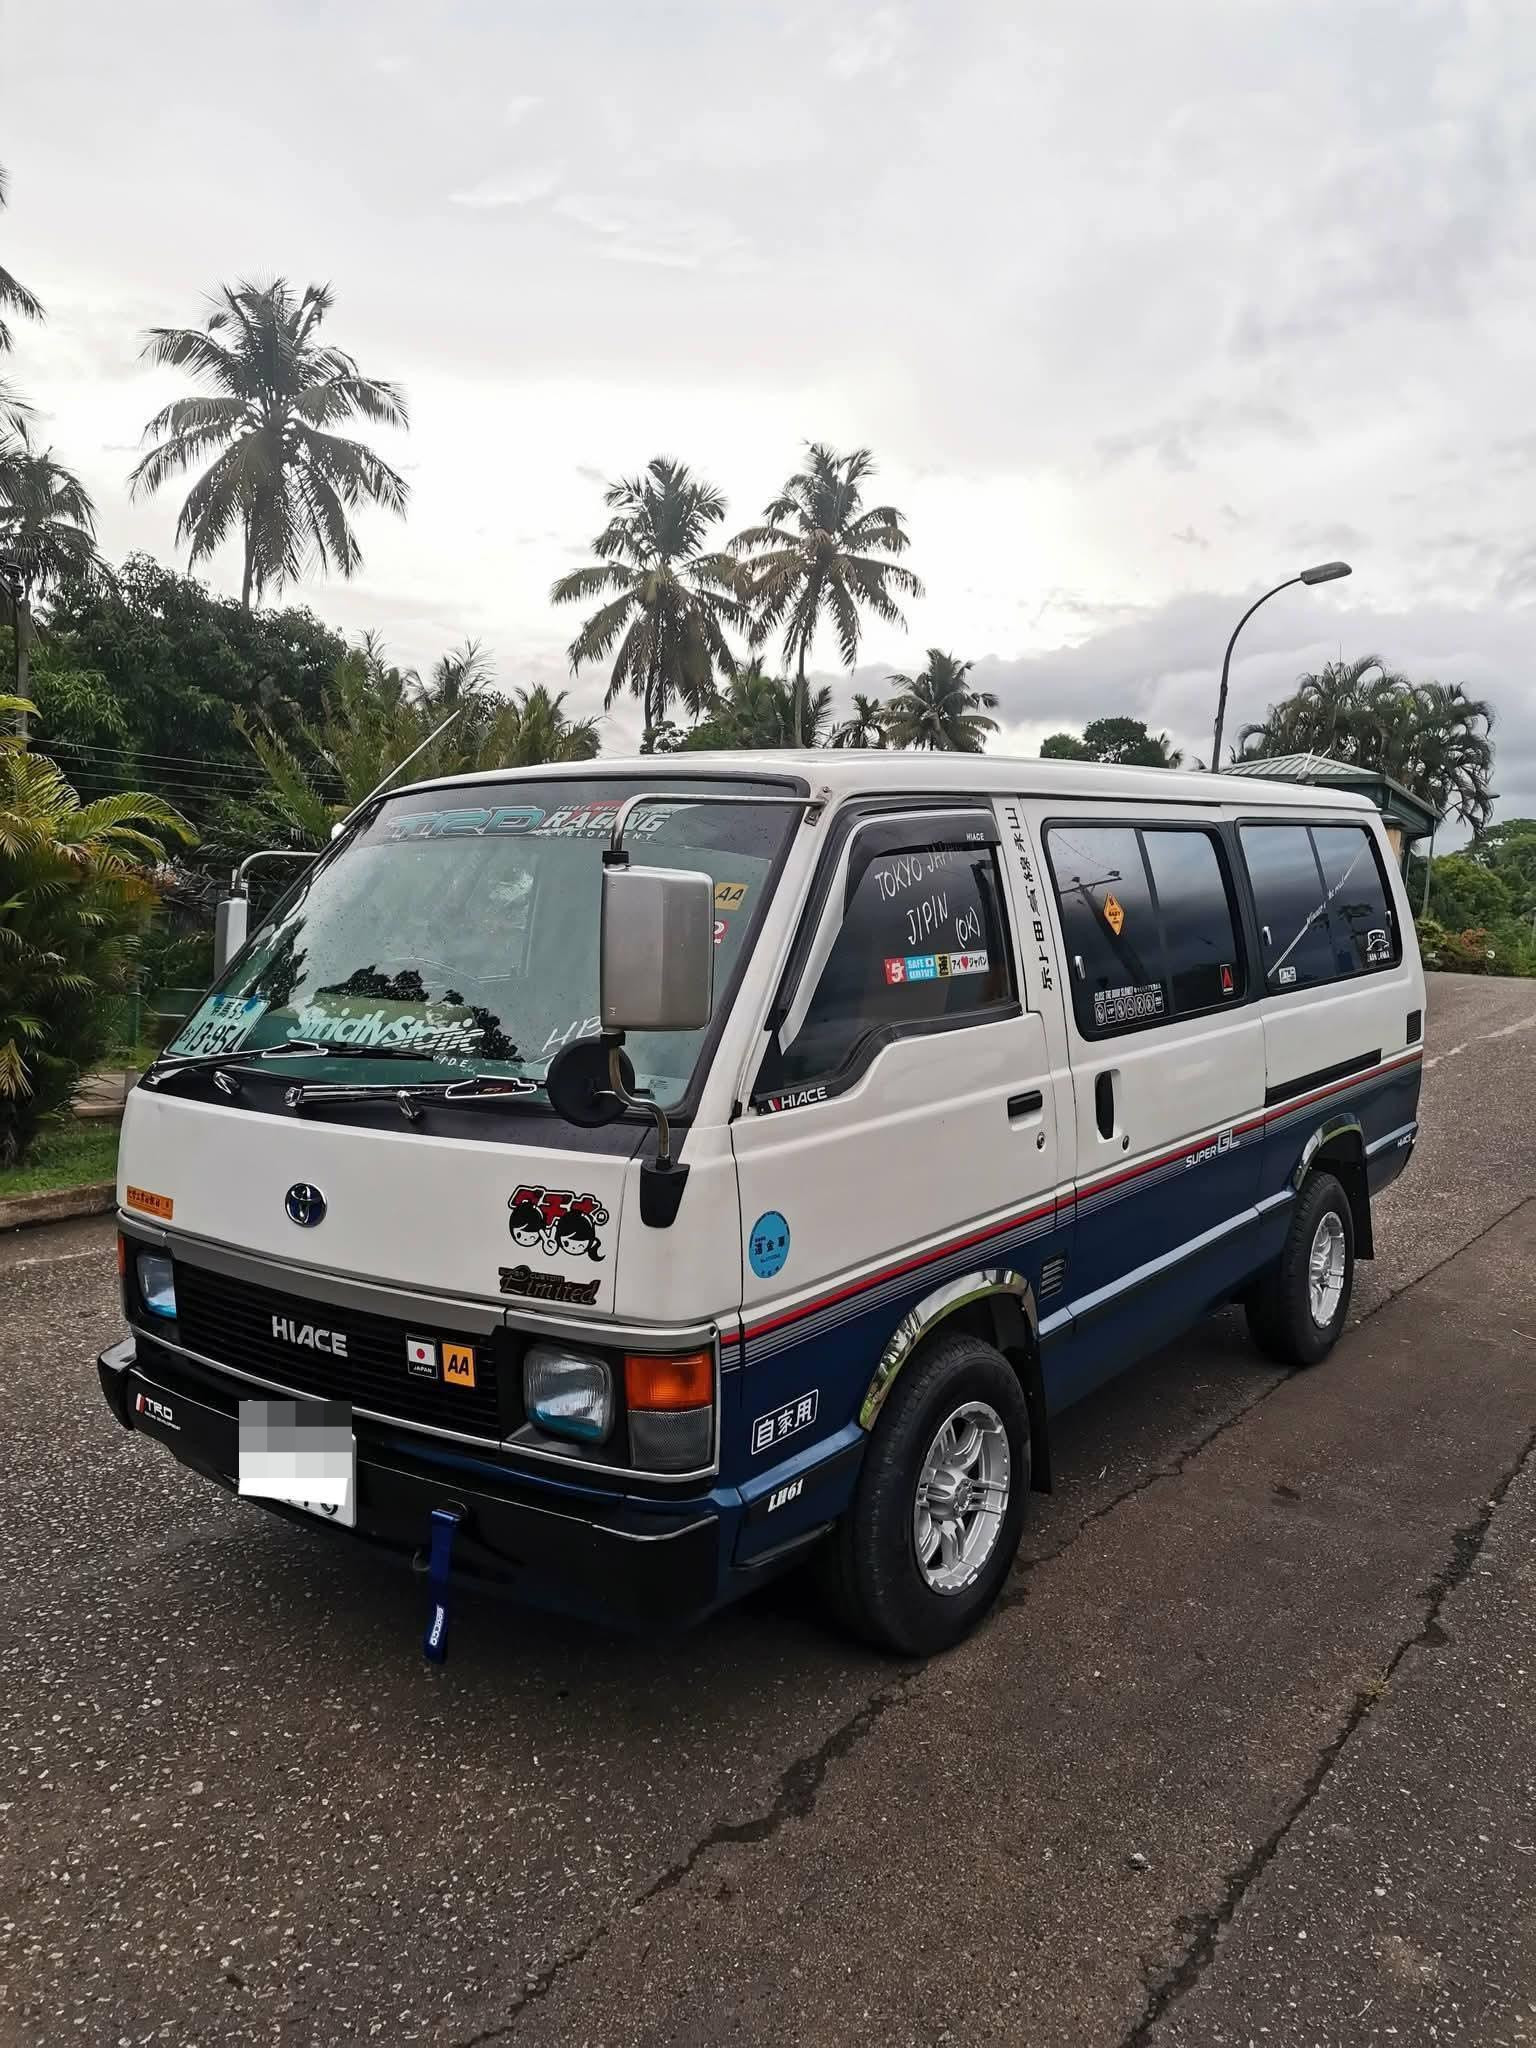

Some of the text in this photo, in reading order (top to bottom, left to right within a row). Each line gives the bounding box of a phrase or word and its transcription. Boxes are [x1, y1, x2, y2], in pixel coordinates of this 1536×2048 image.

[390, 806, 671, 840] TRD RACNG
[966, 832, 985, 841] HIACE
[716, 886, 744, 902] AA
[874, 855, 922, 902] TOKYO
[906, 891, 948, 945] JIPIN
[956, 906, 980, 949] (OK)
[780, 1086, 828, 1109] HIACE
[1185, 1128, 1241, 1168] SUPER GL
[271, 1315, 348, 1357] HIACE
[413, 1365, 433, 1374] JAPAN
[448, 1354, 470, 1376] AA
[145, 1397, 173, 1421] TRD
[756, 1397, 813, 1448] 自家用
[768, 1478, 804, 1513] LH61
